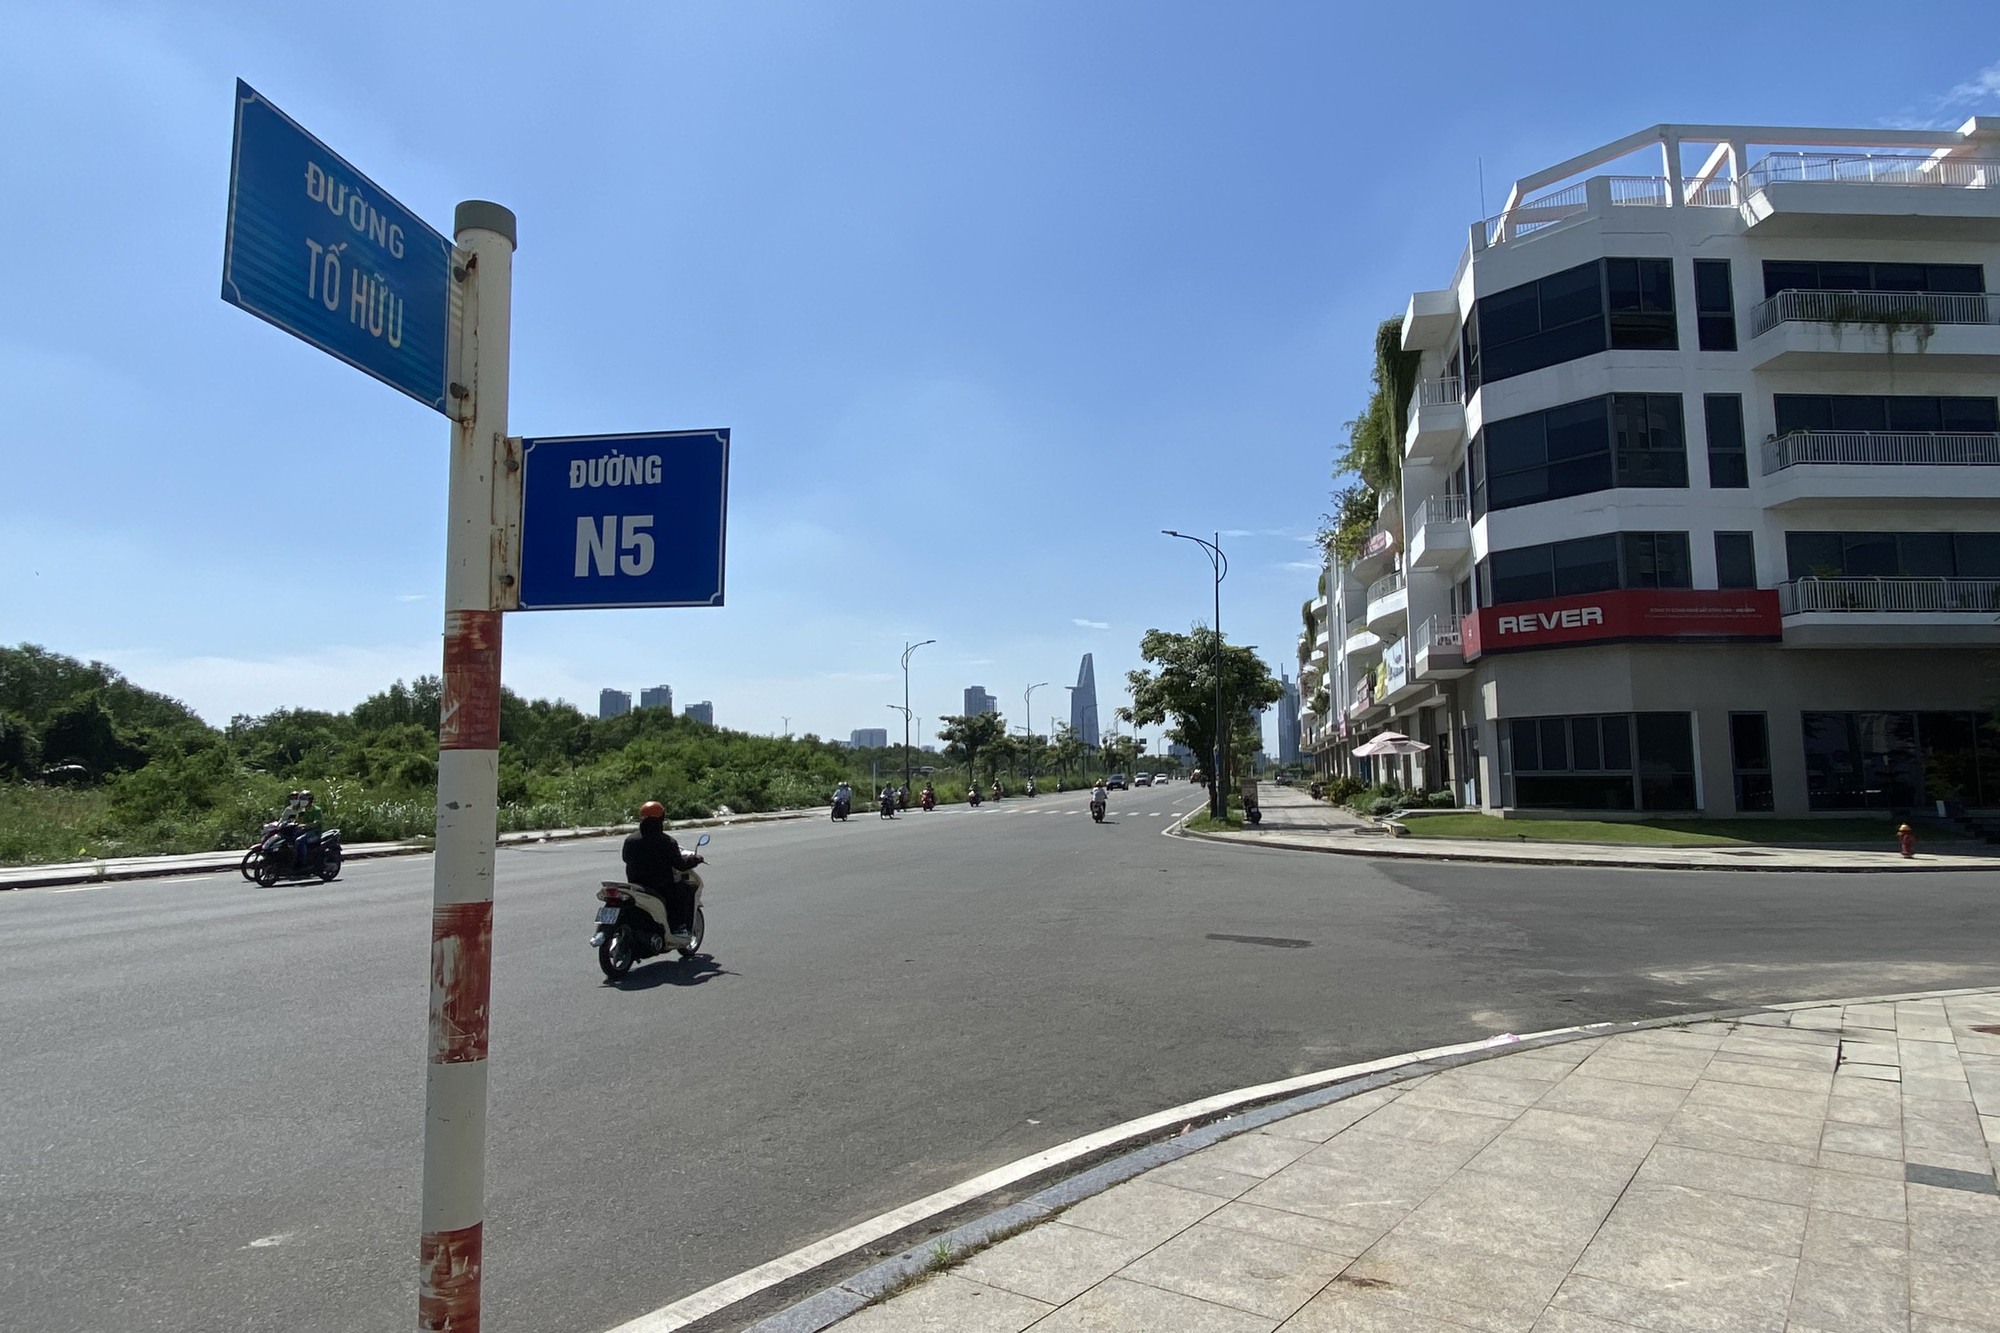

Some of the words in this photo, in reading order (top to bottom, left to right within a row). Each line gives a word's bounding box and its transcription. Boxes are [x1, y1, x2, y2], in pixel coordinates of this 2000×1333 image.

[305, 161, 404, 259] ĐƯỜNG
[306, 237, 348, 312] TỐ
[350, 268, 403, 348] HỮU
[569, 448, 662, 489] ĐƯỜNG
[574, 515, 655, 577] N5
[1498, 606, 1603, 635] REVER
